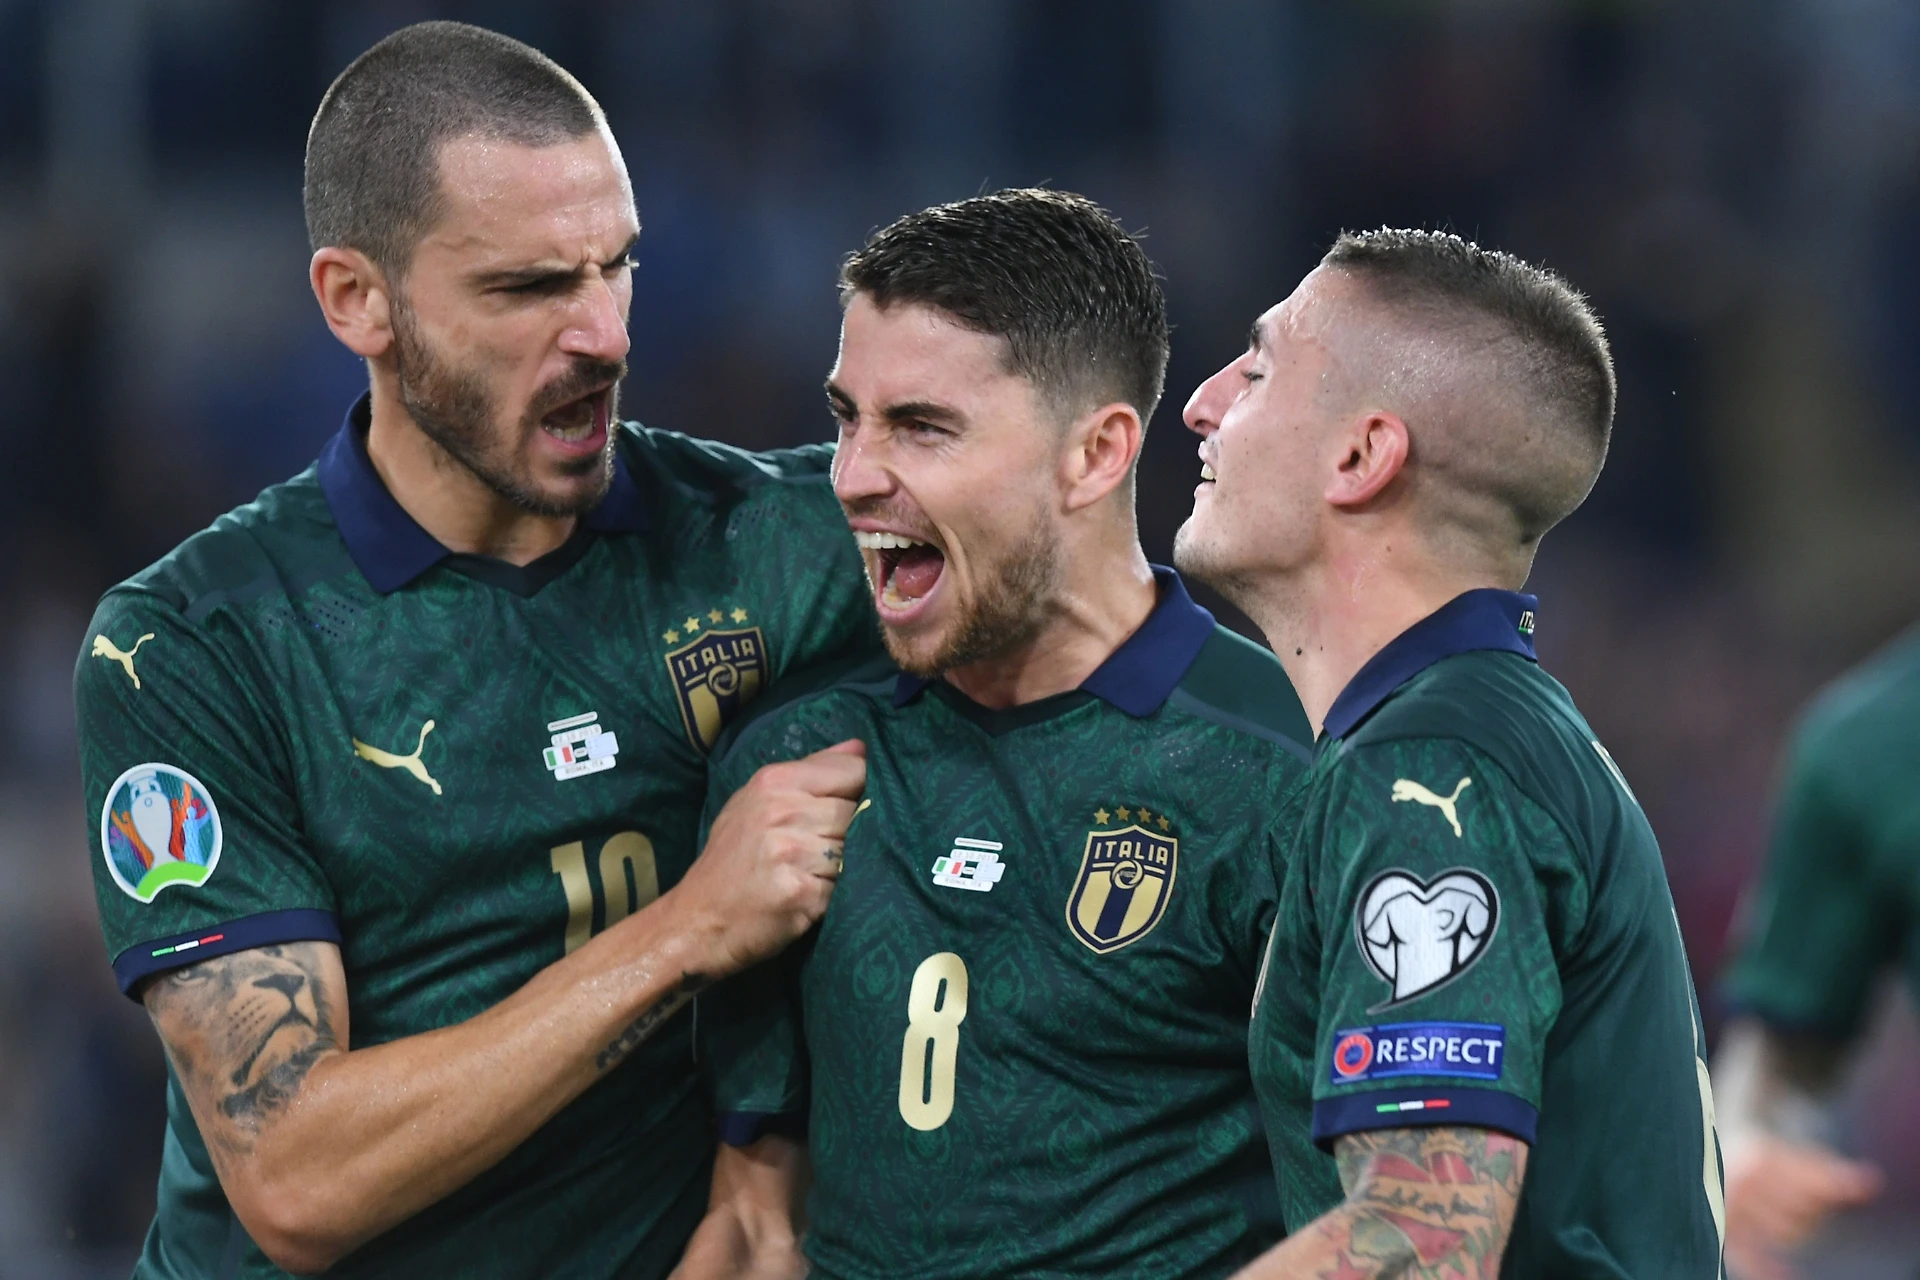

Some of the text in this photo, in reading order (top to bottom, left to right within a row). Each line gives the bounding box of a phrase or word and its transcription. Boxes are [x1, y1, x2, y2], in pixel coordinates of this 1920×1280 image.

[677, 638, 756, 678] ITALIA
[1094, 840, 1169, 866] ITALIA
[899, 952, 969, 1131] 8
[1376, 1036, 1503, 1065] RESPECT
